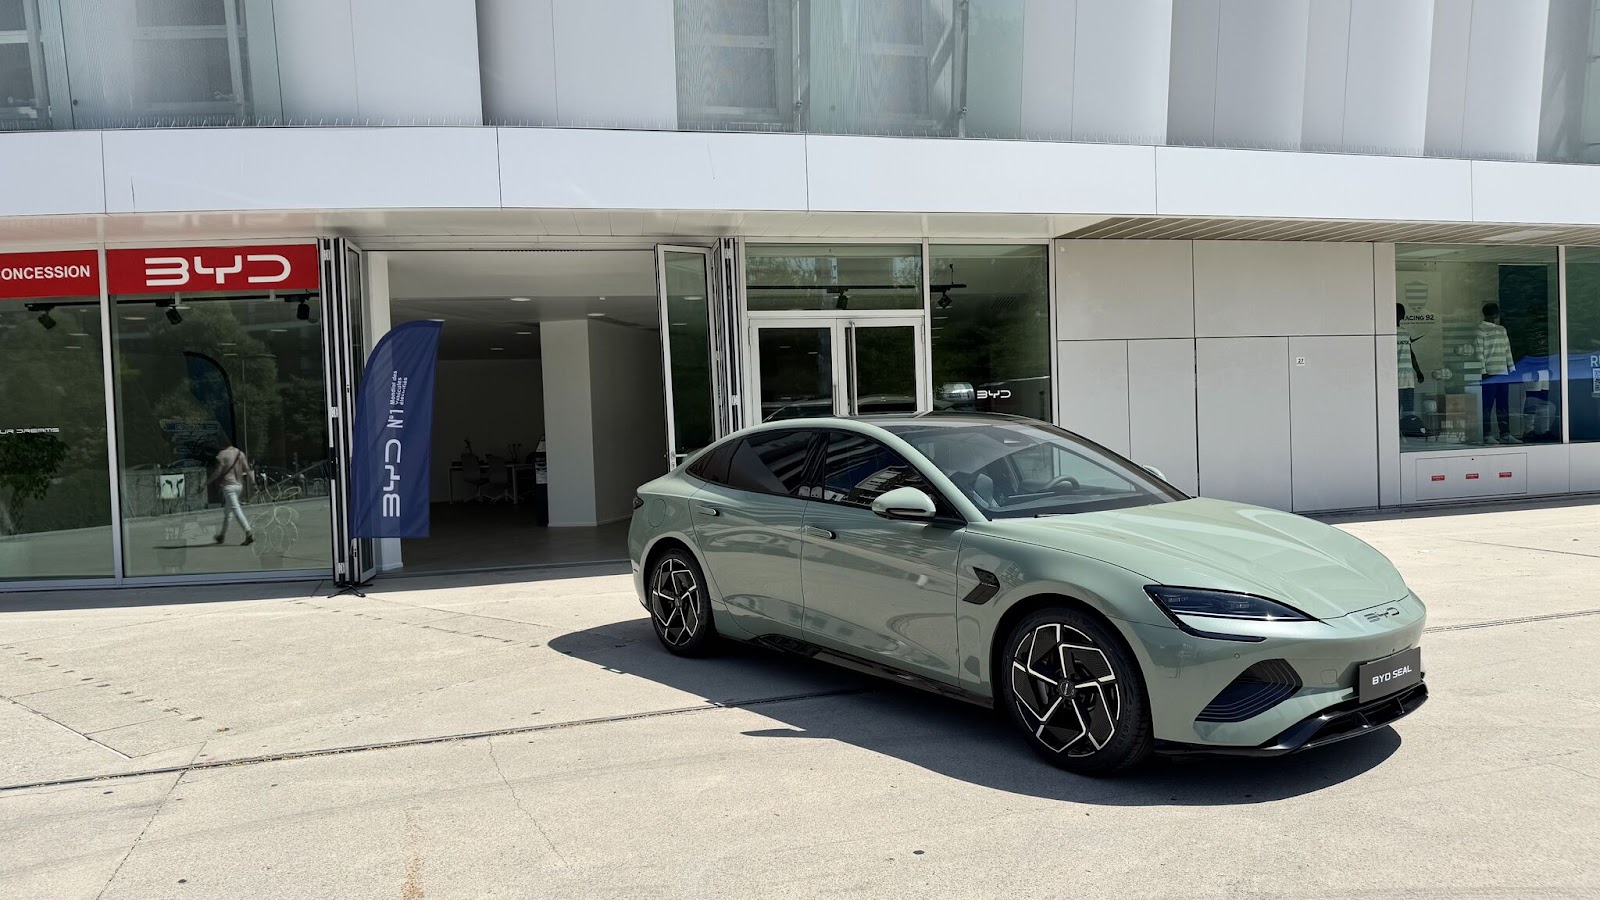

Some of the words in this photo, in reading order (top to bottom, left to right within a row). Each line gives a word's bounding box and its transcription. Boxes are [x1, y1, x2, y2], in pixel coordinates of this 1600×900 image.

[145, 254, 292, 286] BYD
[1591, 355, 1600, 367] R
[389, 382, 397, 405] Mondial
[977, 389, 1011, 399] BYD
[383, 439, 401, 517] BYD
[1364, 607, 1399, 622] BYD
[1372, 672, 1391, 686] BYD
[1392, 665, 1412, 679] SEAL
